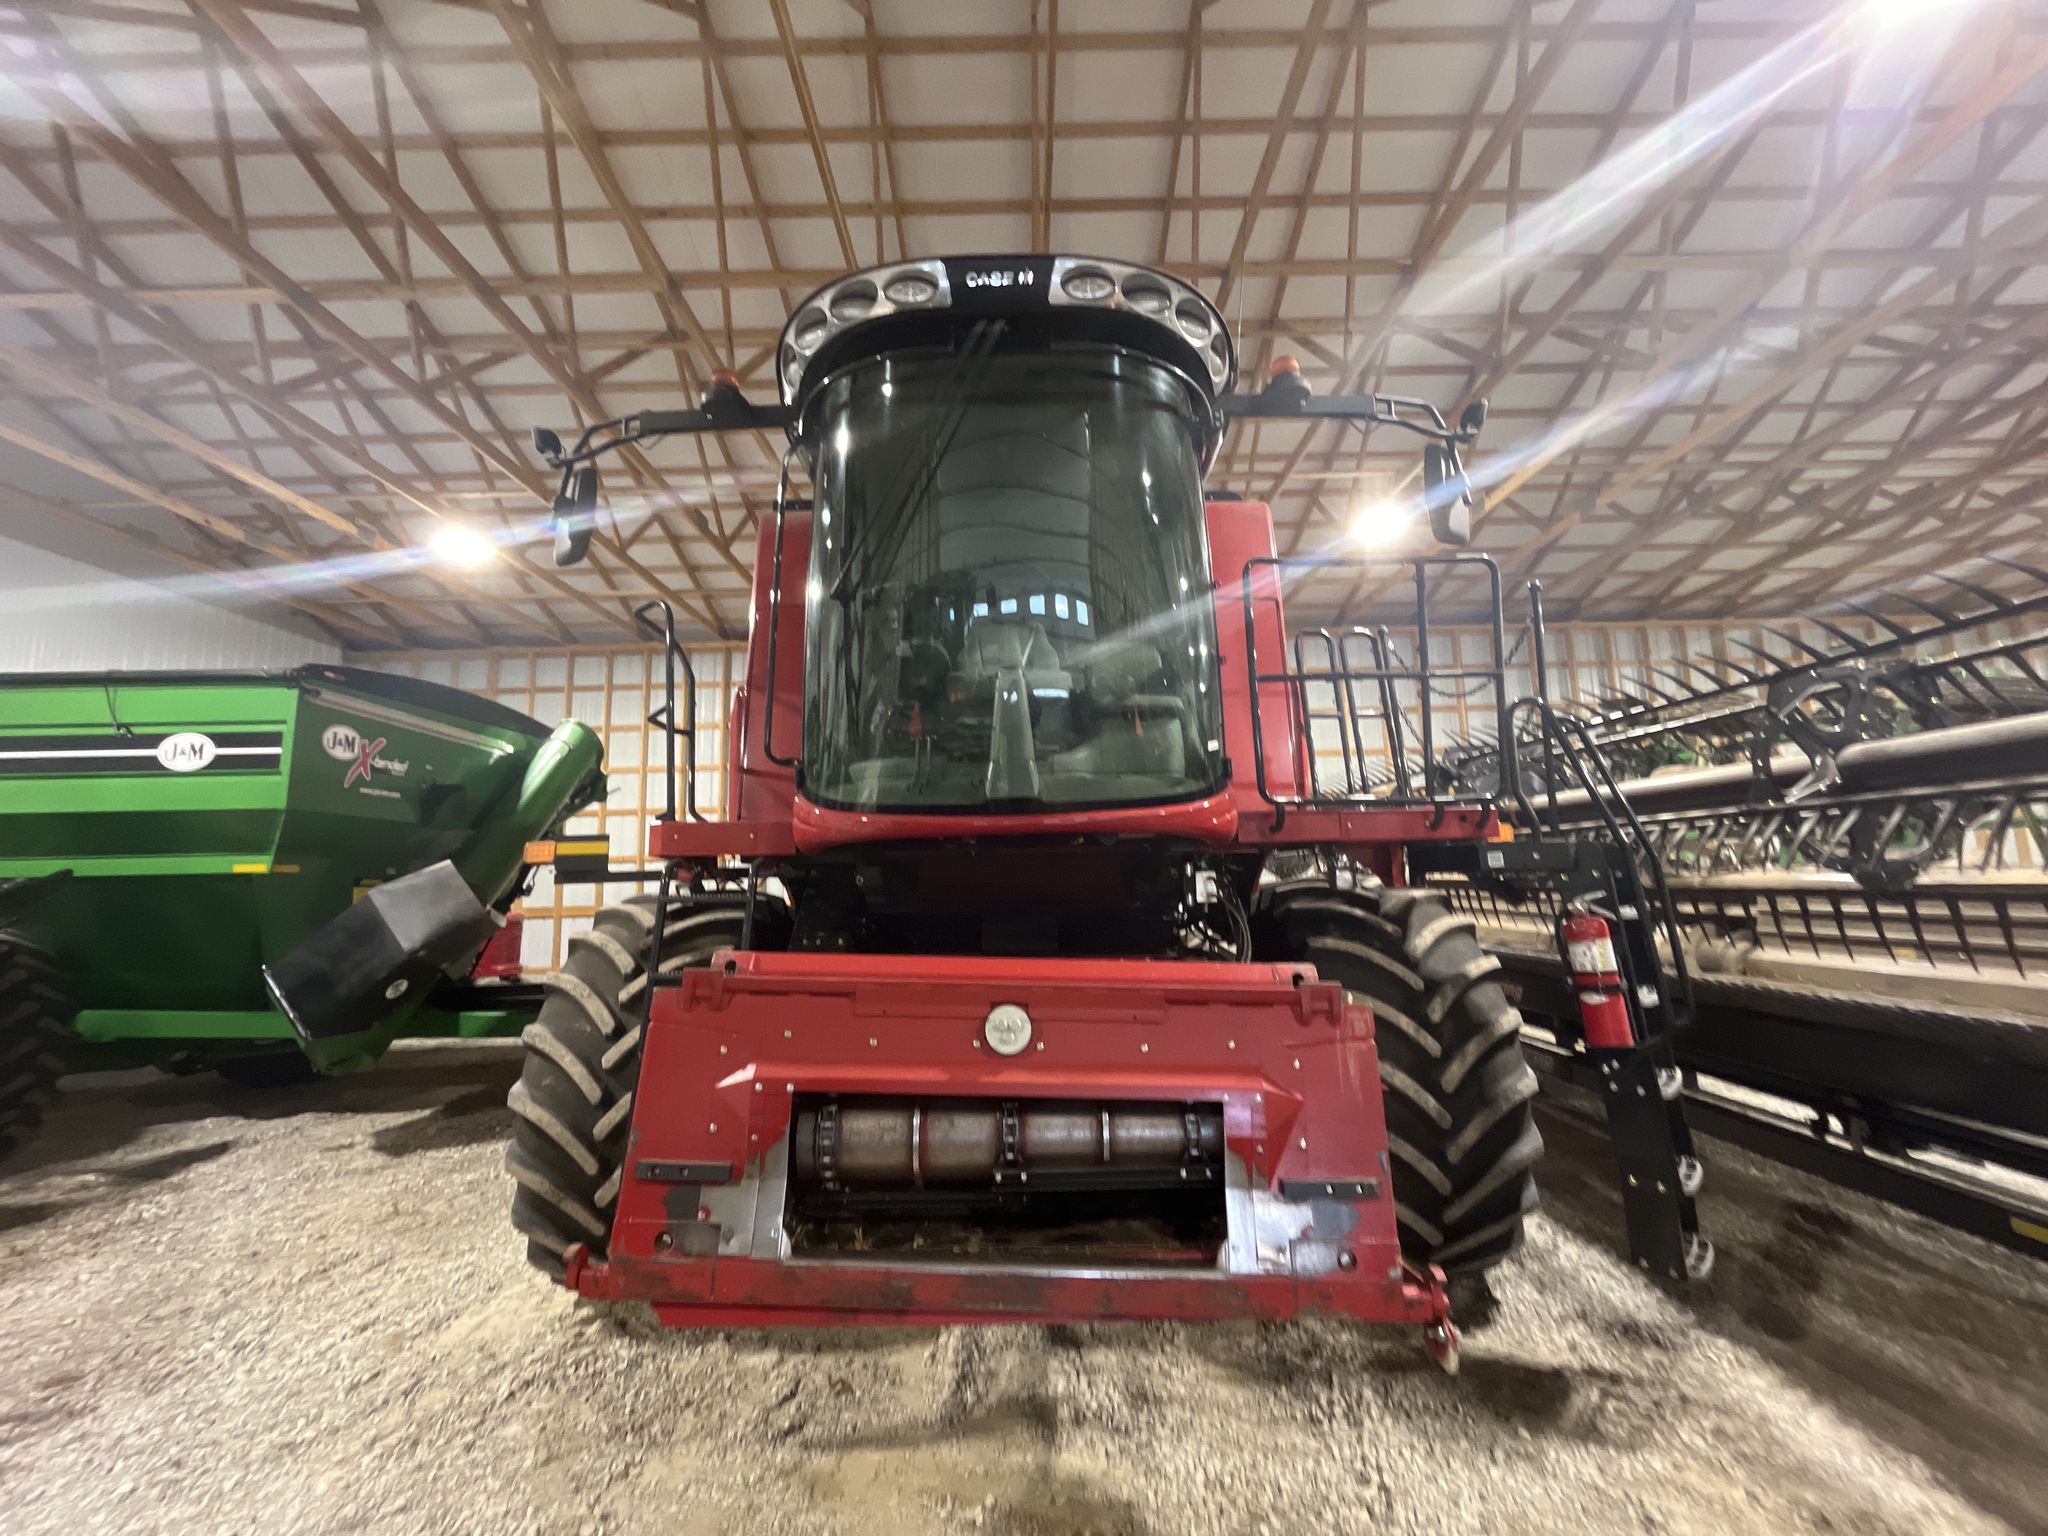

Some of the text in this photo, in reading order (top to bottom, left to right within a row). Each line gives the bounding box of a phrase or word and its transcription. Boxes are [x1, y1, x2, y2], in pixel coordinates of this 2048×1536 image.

[965, 271, 1015, 288] CASE
[164, 742, 206, 762] J&M
[326, 731, 356, 754] J&M
